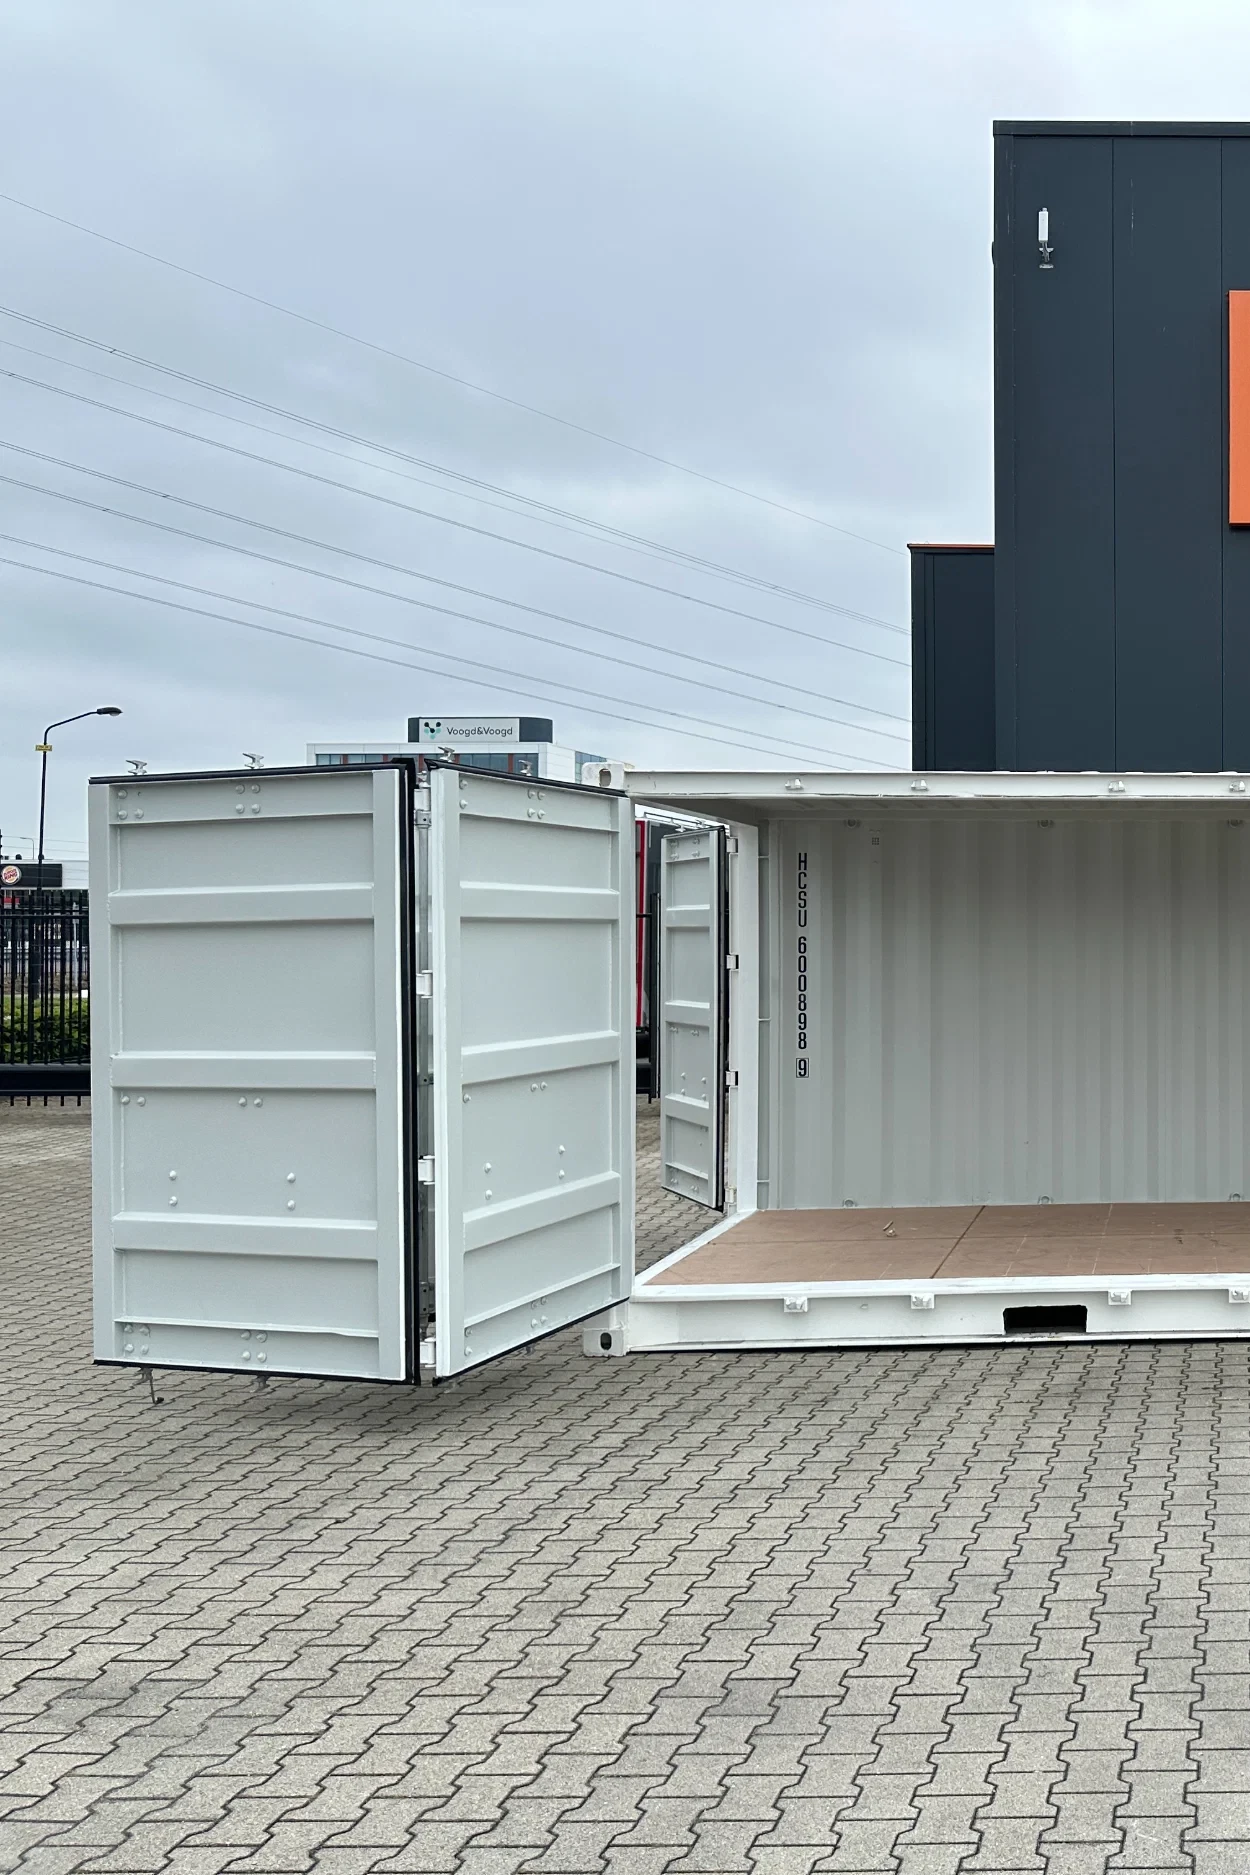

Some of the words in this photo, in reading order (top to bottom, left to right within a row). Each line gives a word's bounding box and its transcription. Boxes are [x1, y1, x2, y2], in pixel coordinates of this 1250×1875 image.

[446, 726, 513, 738] Voogd&Voogd
[798, 852, 808, 928] HCSU
[798, 936, 807, 1050] 600898
[797, 1058, 808, 1077] 9
